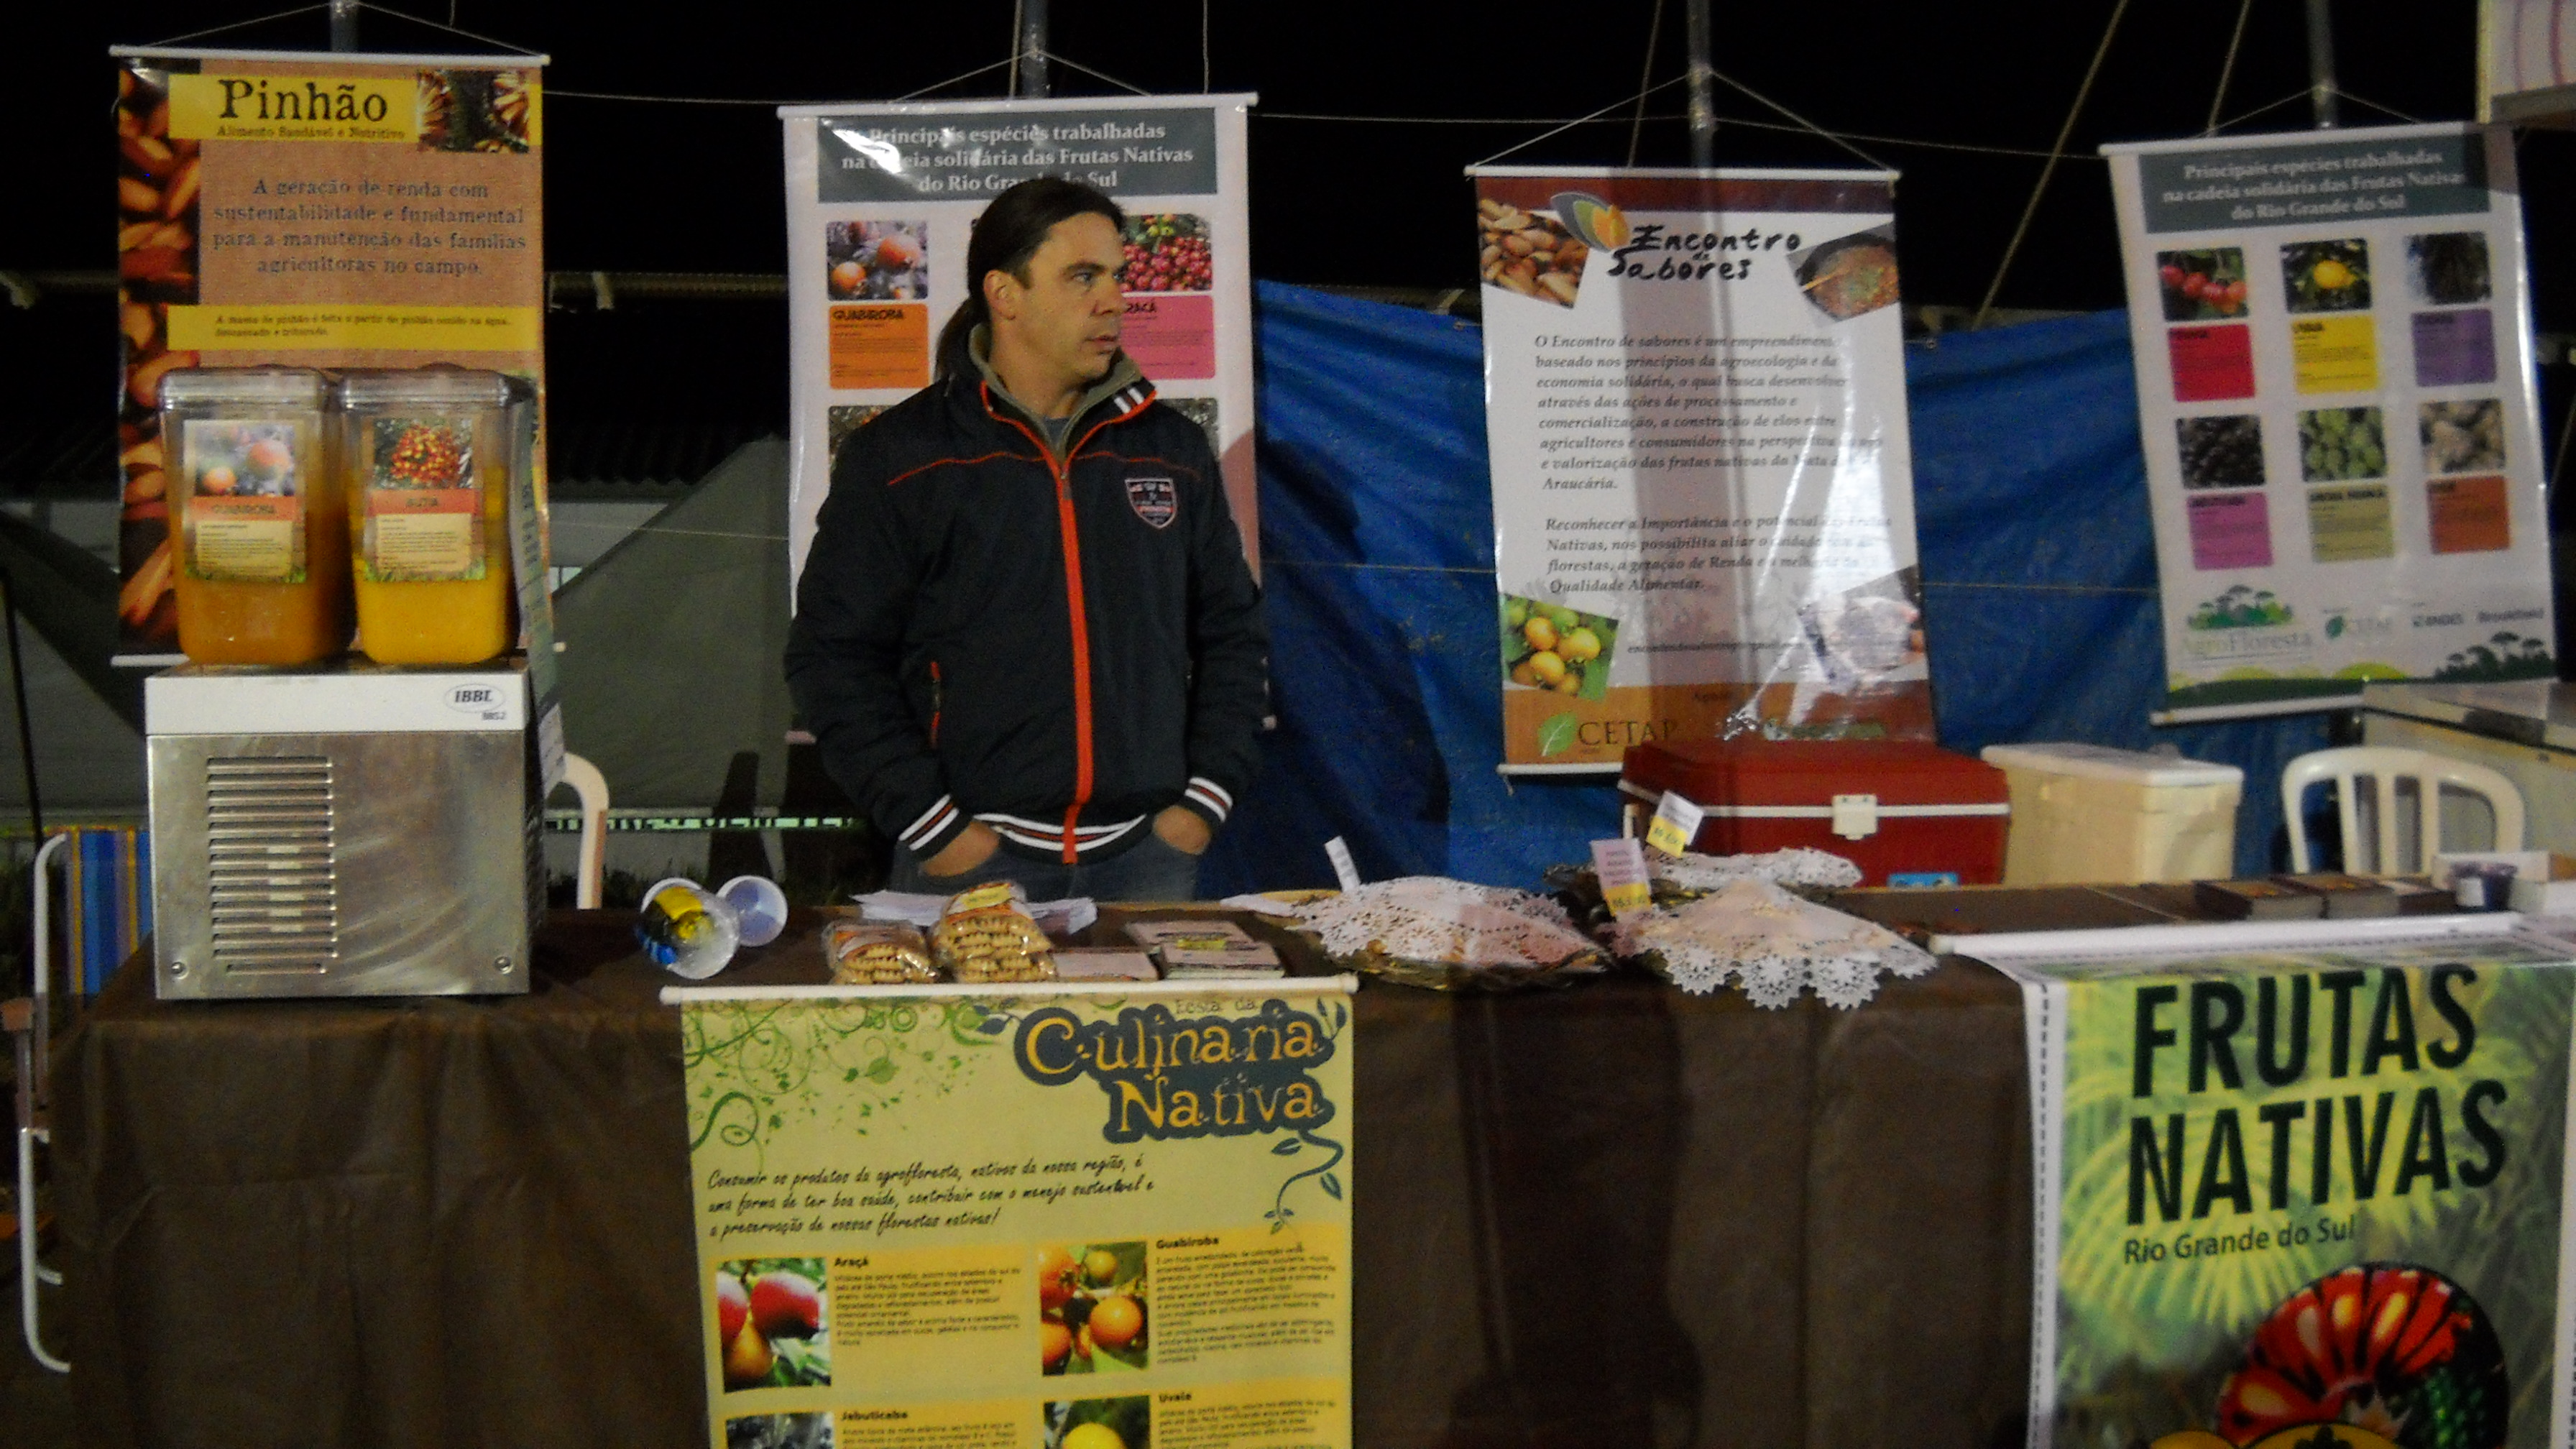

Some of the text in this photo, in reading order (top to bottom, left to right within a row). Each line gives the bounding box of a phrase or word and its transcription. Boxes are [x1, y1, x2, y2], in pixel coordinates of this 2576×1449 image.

[218, 79, 387, 121] Pinhão
[869, 122, 1166, 149] Principis espécies trabalhadas
[842, 155, 865, 170] na
[870, 150, 930, 169] ceia
[1022, 148, 1055, 166] das
[1060, 147, 1118, 165] Frutas
[1123, 147, 1193, 163] Nativas
[2184, 151, 2443, 180] Principais espécies trabalhadas
[252, 179, 489, 198] A geração de renda com
[919, 175, 943, 193] do
[948, 173, 980, 192] Rio
[1086, 170, 1118, 188] Sul
[2163, 192, 2184, 203] na
[2186, 185, 2240, 201] cadeia
[2244, 180, 2317, 196] solidária
[2319, 178, 2349, 193] das
[2351, 175, 2405, 190] Frutas
[213, 204, 377, 221] sustentabilidade
[401, 206, 523, 224] fundamental
[2231, 193, 2406, 221] do Rio Grande do Sul
[213, 234, 256, 251] para
[264, 234, 275, 247] a
[282, 232, 402, 250] manutenção
[410, 232, 441, 249] das
[1631, 225, 1800, 251] Encontro
[1608, 247, 1752, 280] Sabores
[1693, 252, 1710, 261] de
[384, 260, 407, 274] no
[1535, 336, 1547, 347] O
[1552, 335, 1615, 347] Encontro
[1619, 334, 1634, 347] de
[1638, 335, 1690, 347] sabores
[1535, 356, 1592, 368] baseado
[1597, 358, 1620, 367] nos
[1626, 355, 1694, 370] princípios
[1699, 355, 1715, 367] da
[1720, 355, 1807, 370] agroecologia
[1537, 378, 1604, 388] economia
[1692, 377, 1721, 390] qual
[1538, 397, 1590, 408] através
[1594, 396, 1619, 408] das
[1623, 396, 1660, 410] ações
[1664, 395, 1680, 408] de
[1684, 397, 1787, 410] processamento
[1539, 416, 1656, 431] comercialização,
[1674, 416, 1749, 430] construção
[1754, 415, 1768, 426] de
[1772, 414, 1800, 426] elos
[1540, 436, 1625, 452] agricultores
[1629, 439, 1635, 448] e
[1639, 435, 1733, 448] consumidores
[1760, 437, 1836, 449] perspetiva
[1541, 460, 1548, 469] e
[1552, 457, 1637, 470] valorização
[1641, 456, 1665, 468] das
[1668, 456, 1711, 472] frutas
[1714, 456, 1767, 467] nativas
[1771, 455, 1788, 466] da
[1542, 477, 1617, 490] Araucária.
[1545, 518, 1624, 530] Reconhecer
[1641, 517, 1728, 533] Importância
[1757, 515, 1818, 530] potncial
[1547, 540, 1606, 551] Nativas,
[1611, 541, 1637, 550] nos
[1640, 538, 1715, 553] possibilita
[1721, 535, 1754, 547] aliar
[1547, 558, 1614, 575] florestas,
[1617, 562, 1627, 571] a
[1629, 558, 1684, 574] geração
[1688, 556, 1704, 569] de
[1710, 556, 1752, 569] Renda
[1550, 579, 1704, 594] Qualidade Alimentar.
[455, 690, 493, 703] IBBL
[2133, 962, 2478, 1099] FRUTAS
[1116, 1077, 1325, 1132] Nativa
[2127, 1079, 2508, 1226] NATIVAS
[707, 1168, 767, 1190] Consumir
[773, 1174, 788, 1184] os
[791, 1167, 850, 1191] produtos
[855, 1167, 870, 1182] da
[876, 1161, 962, 1189] agrofloresta,
[1022, 1155, 1036, 1174] da
[1043, 1161, 1077, 1173] nossa
[708, 1200, 732, 1213] uma
[737, 1192, 776, 1217] forma
[782, 1192, 796, 1208] de
[804, 1195, 827, 1208] ter
[832, 1191, 853, 1208] boa
[908, 1186, 972, 1203] contribuir
[979, 1191, 1003, 1201] com
[1008, 1190, 1016, 1200] o
[1022, 1183, 1066, 1205] manejo
[1146, 1181, 1154, 1191] e
[709, 1225, 717, 1236] a
[720, 1218, 804, 1243] preservação
[809, 1215, 824, 1231] de
[831, 1220, 873, 1232] nossas
[876, 1212, 939, 1237] florestas
[1156, 1237, 1219, 1249] Guabiroba
[2124, 1214, 2355, 1264] Rio Grande do Sul
[834, 1257, 869, 1269] Araçá
[842, 1411, 908, 1421] Jabuticaba
